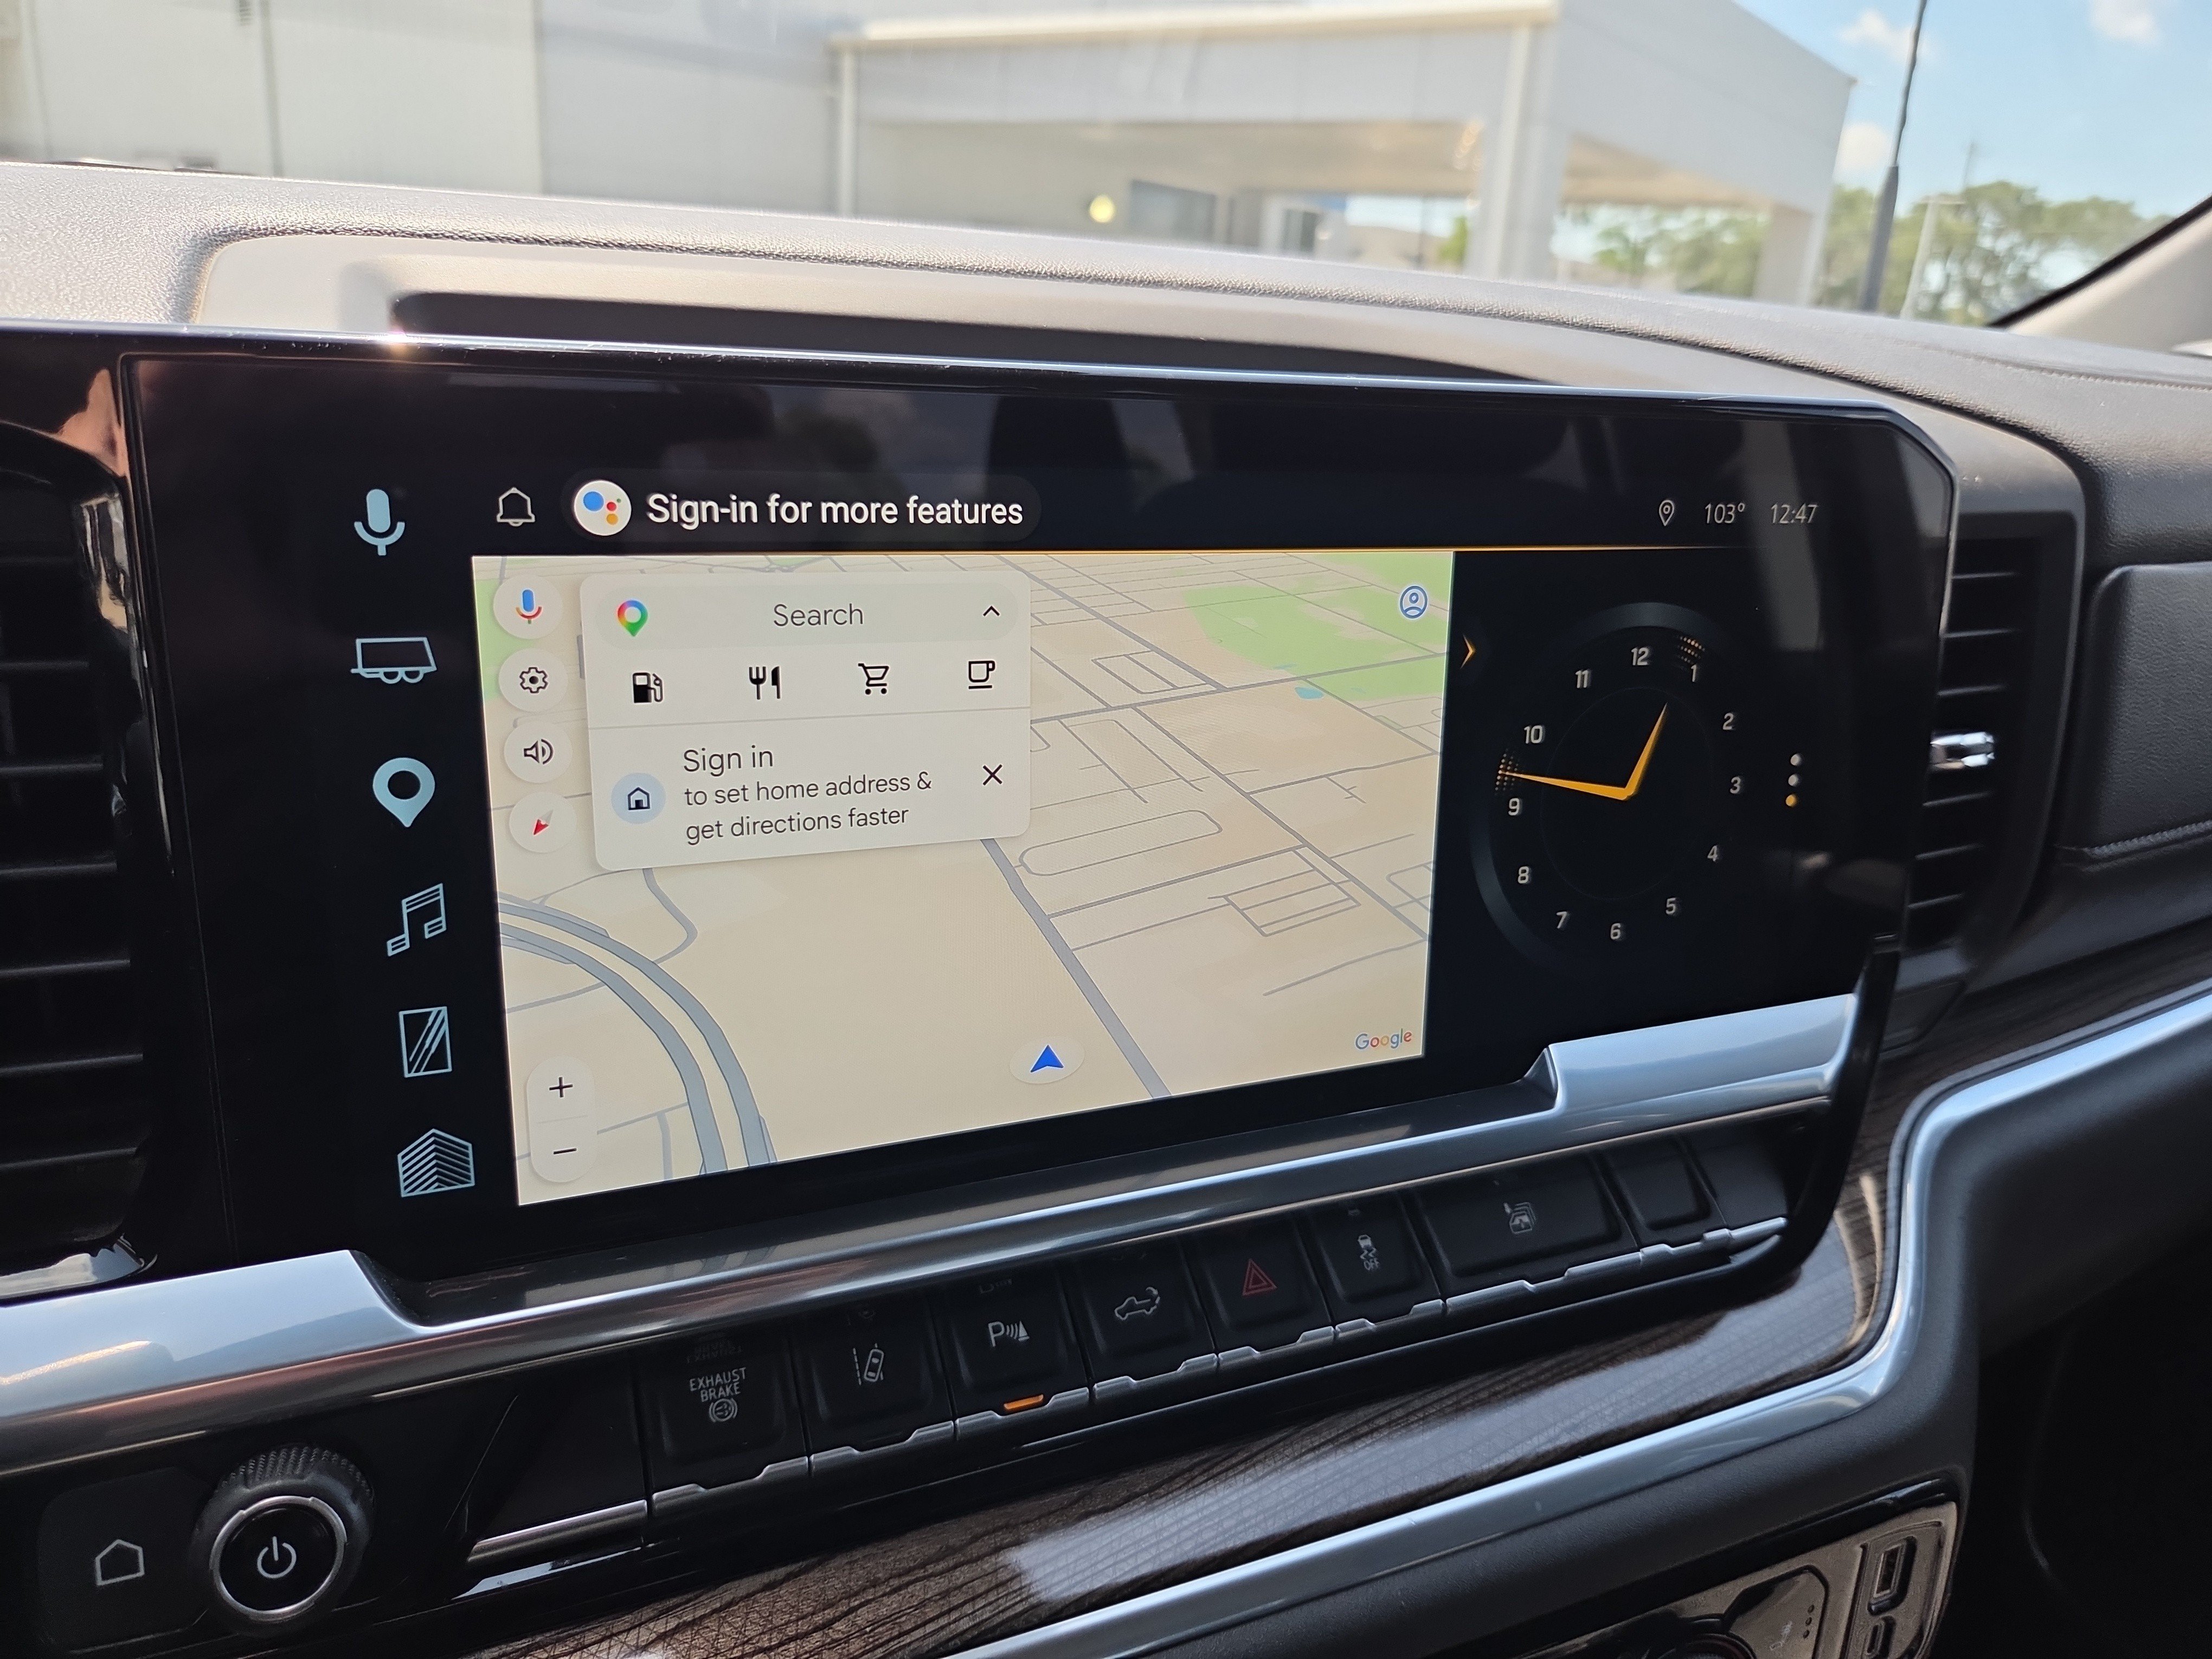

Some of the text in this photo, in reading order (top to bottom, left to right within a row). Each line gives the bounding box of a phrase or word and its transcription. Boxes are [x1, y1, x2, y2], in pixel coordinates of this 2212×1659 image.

[646, 493, 1024, 530] Sign-in for more features
[1770, 503, 1818, 524] 12:47
[773, 603, 863, 627] Search
[1631, 647, 1650, 666] 12
[1575, 670, 1590, 689] 11
[1690, 664, 1697, 683] 1
[1722, 712, 1734, 731] 2
[1523, 725, 1545, 744] 10
[684, 744, 774, 777] Sign in
[684, 771, 933, 806] to set home address &
[1729, 776, 1742, 794] 3
[1508, 798, 1521, 816] 9
[686, 807, 910, 846] get directions faster
[1707, 845, 1719, 862] 4
[1517, 866, 1530, 884] 8
[1666, 897, 1677, 915] 5
[1556, 911, 1568, 929] 7
[1610, 923, 1622, 940] 6
[1355, 1028, 1412, 1050] Google
[988, 1321, 1005, 1347] P
[689, 1366, 747, 1392] EXHAUST
[700, 1381, 741, 1403] BRAKE
